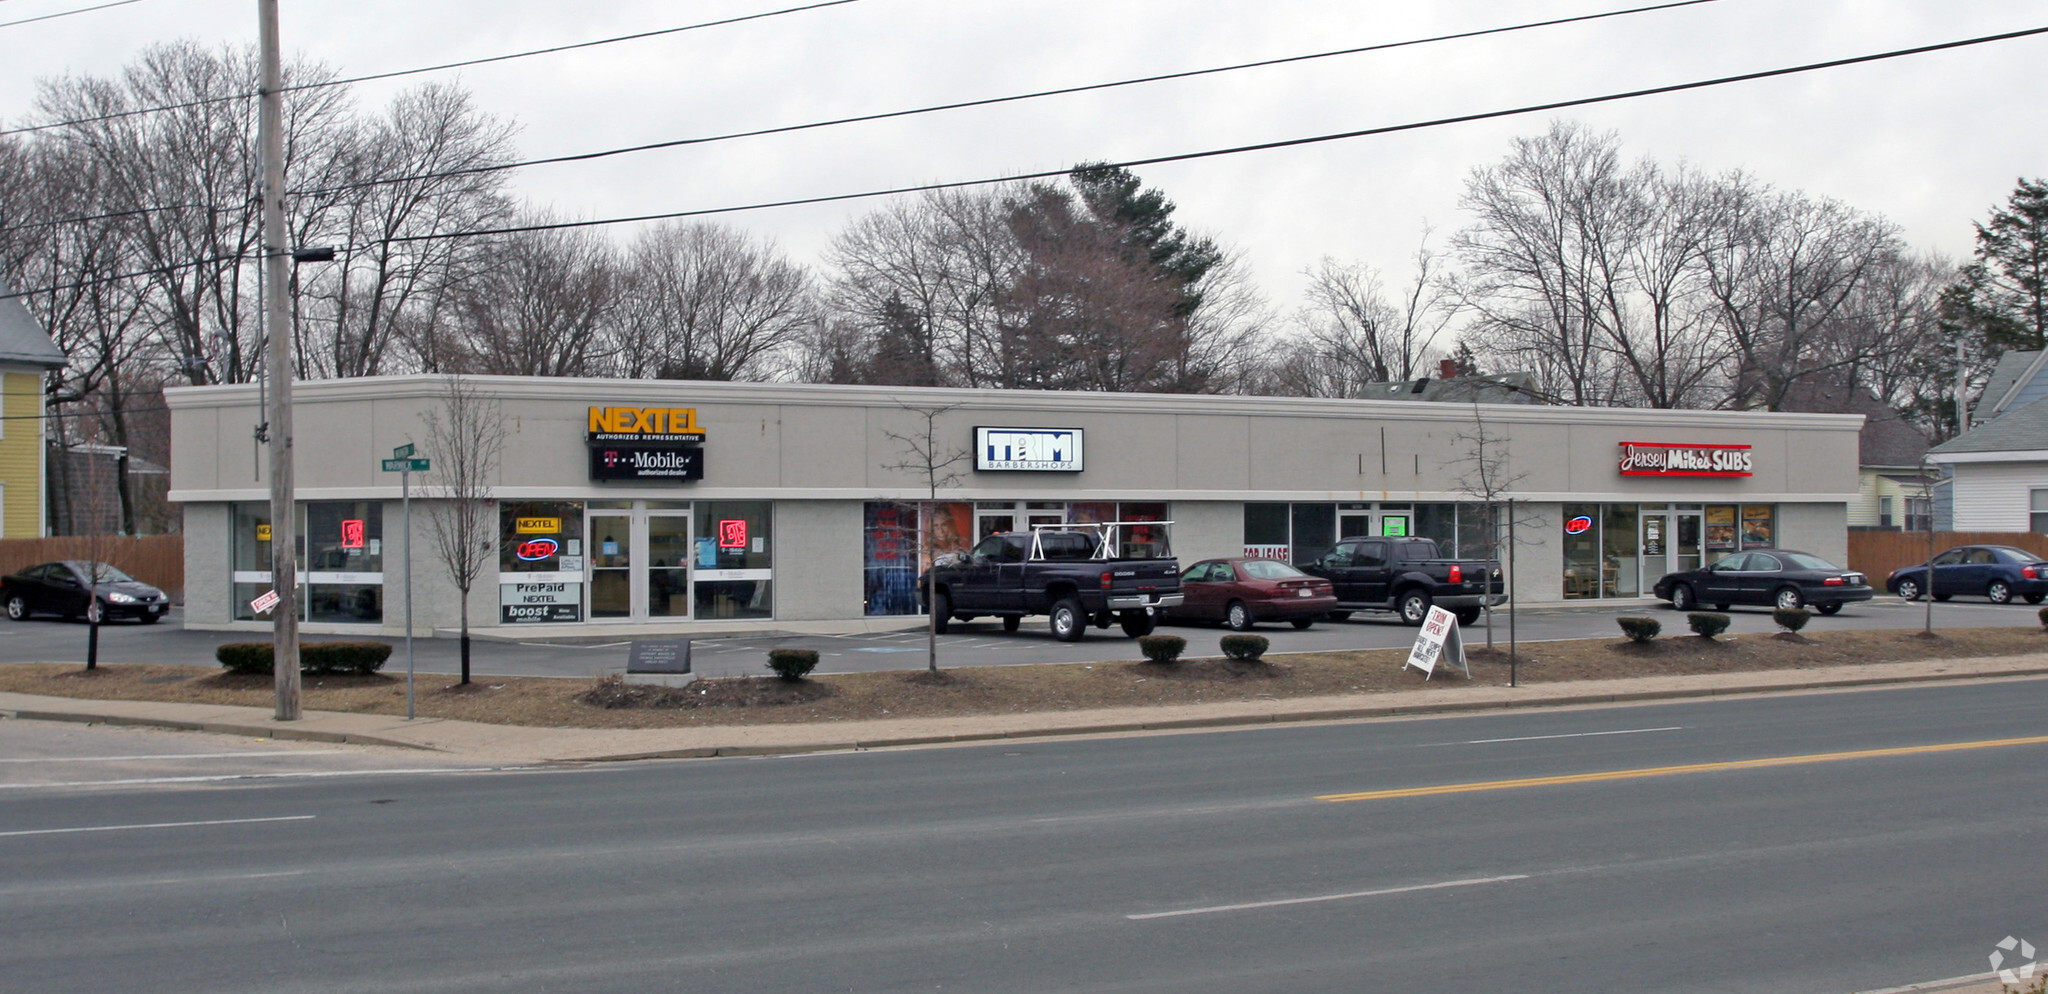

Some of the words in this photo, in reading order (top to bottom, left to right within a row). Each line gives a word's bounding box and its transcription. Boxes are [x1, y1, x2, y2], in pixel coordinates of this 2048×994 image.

[588, 406, 706, 433] NEXTEL
[1620, 444, 1666, 472] Jersey
[1667, 449, 1712, 470] Mike's
[1712, 449, 1752, 471] SUBS
[988, 461, 1072, 470] BARBERSHOPS
[637, 469, 668, 477] authorized
[518, 520, 555, 529] NEXTEL
[1565, 519, 1591, 532] OPEN
[517, 541, 556, 557] OPEN
[516, 583, 565, 593] PrePaid
[523, 595, 557, 603] NEXTEL
[508, 605, 550, 617] boost
